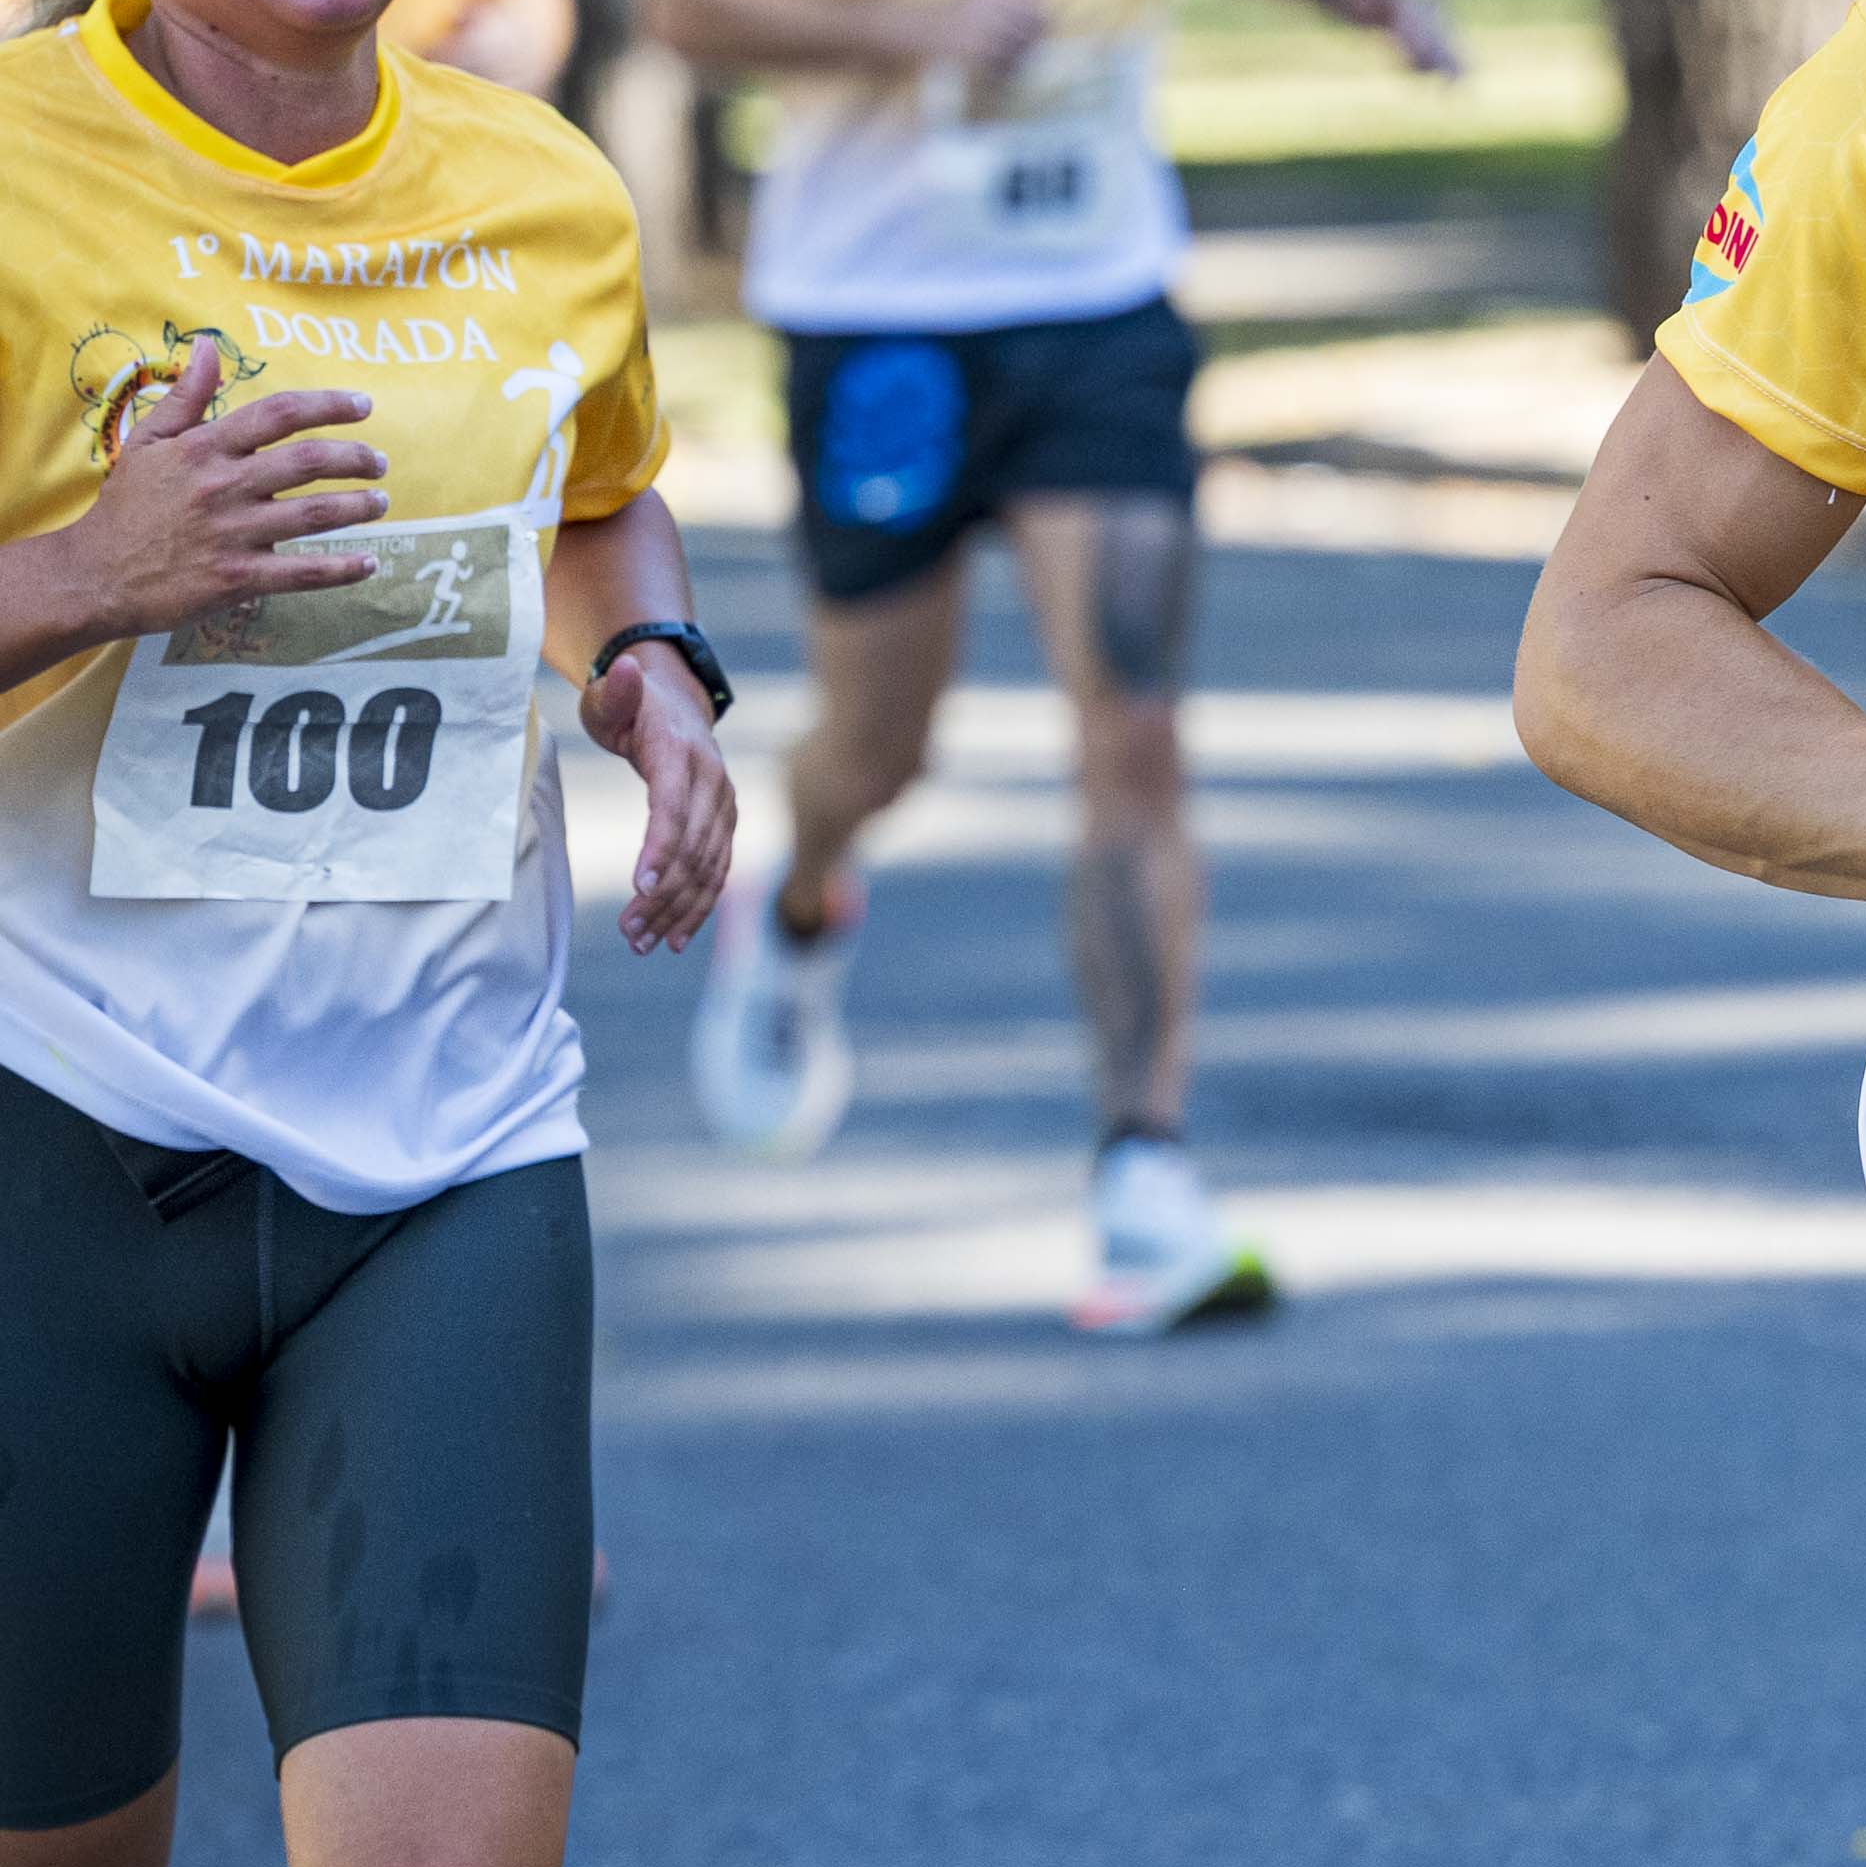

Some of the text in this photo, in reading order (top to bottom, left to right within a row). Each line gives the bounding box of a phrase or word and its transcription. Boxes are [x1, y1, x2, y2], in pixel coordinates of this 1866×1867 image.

[240, 229, 517, 294] MARATÓN
[246, 304, 497, 364] DORADA
[182, 687, 442, 813] 100
